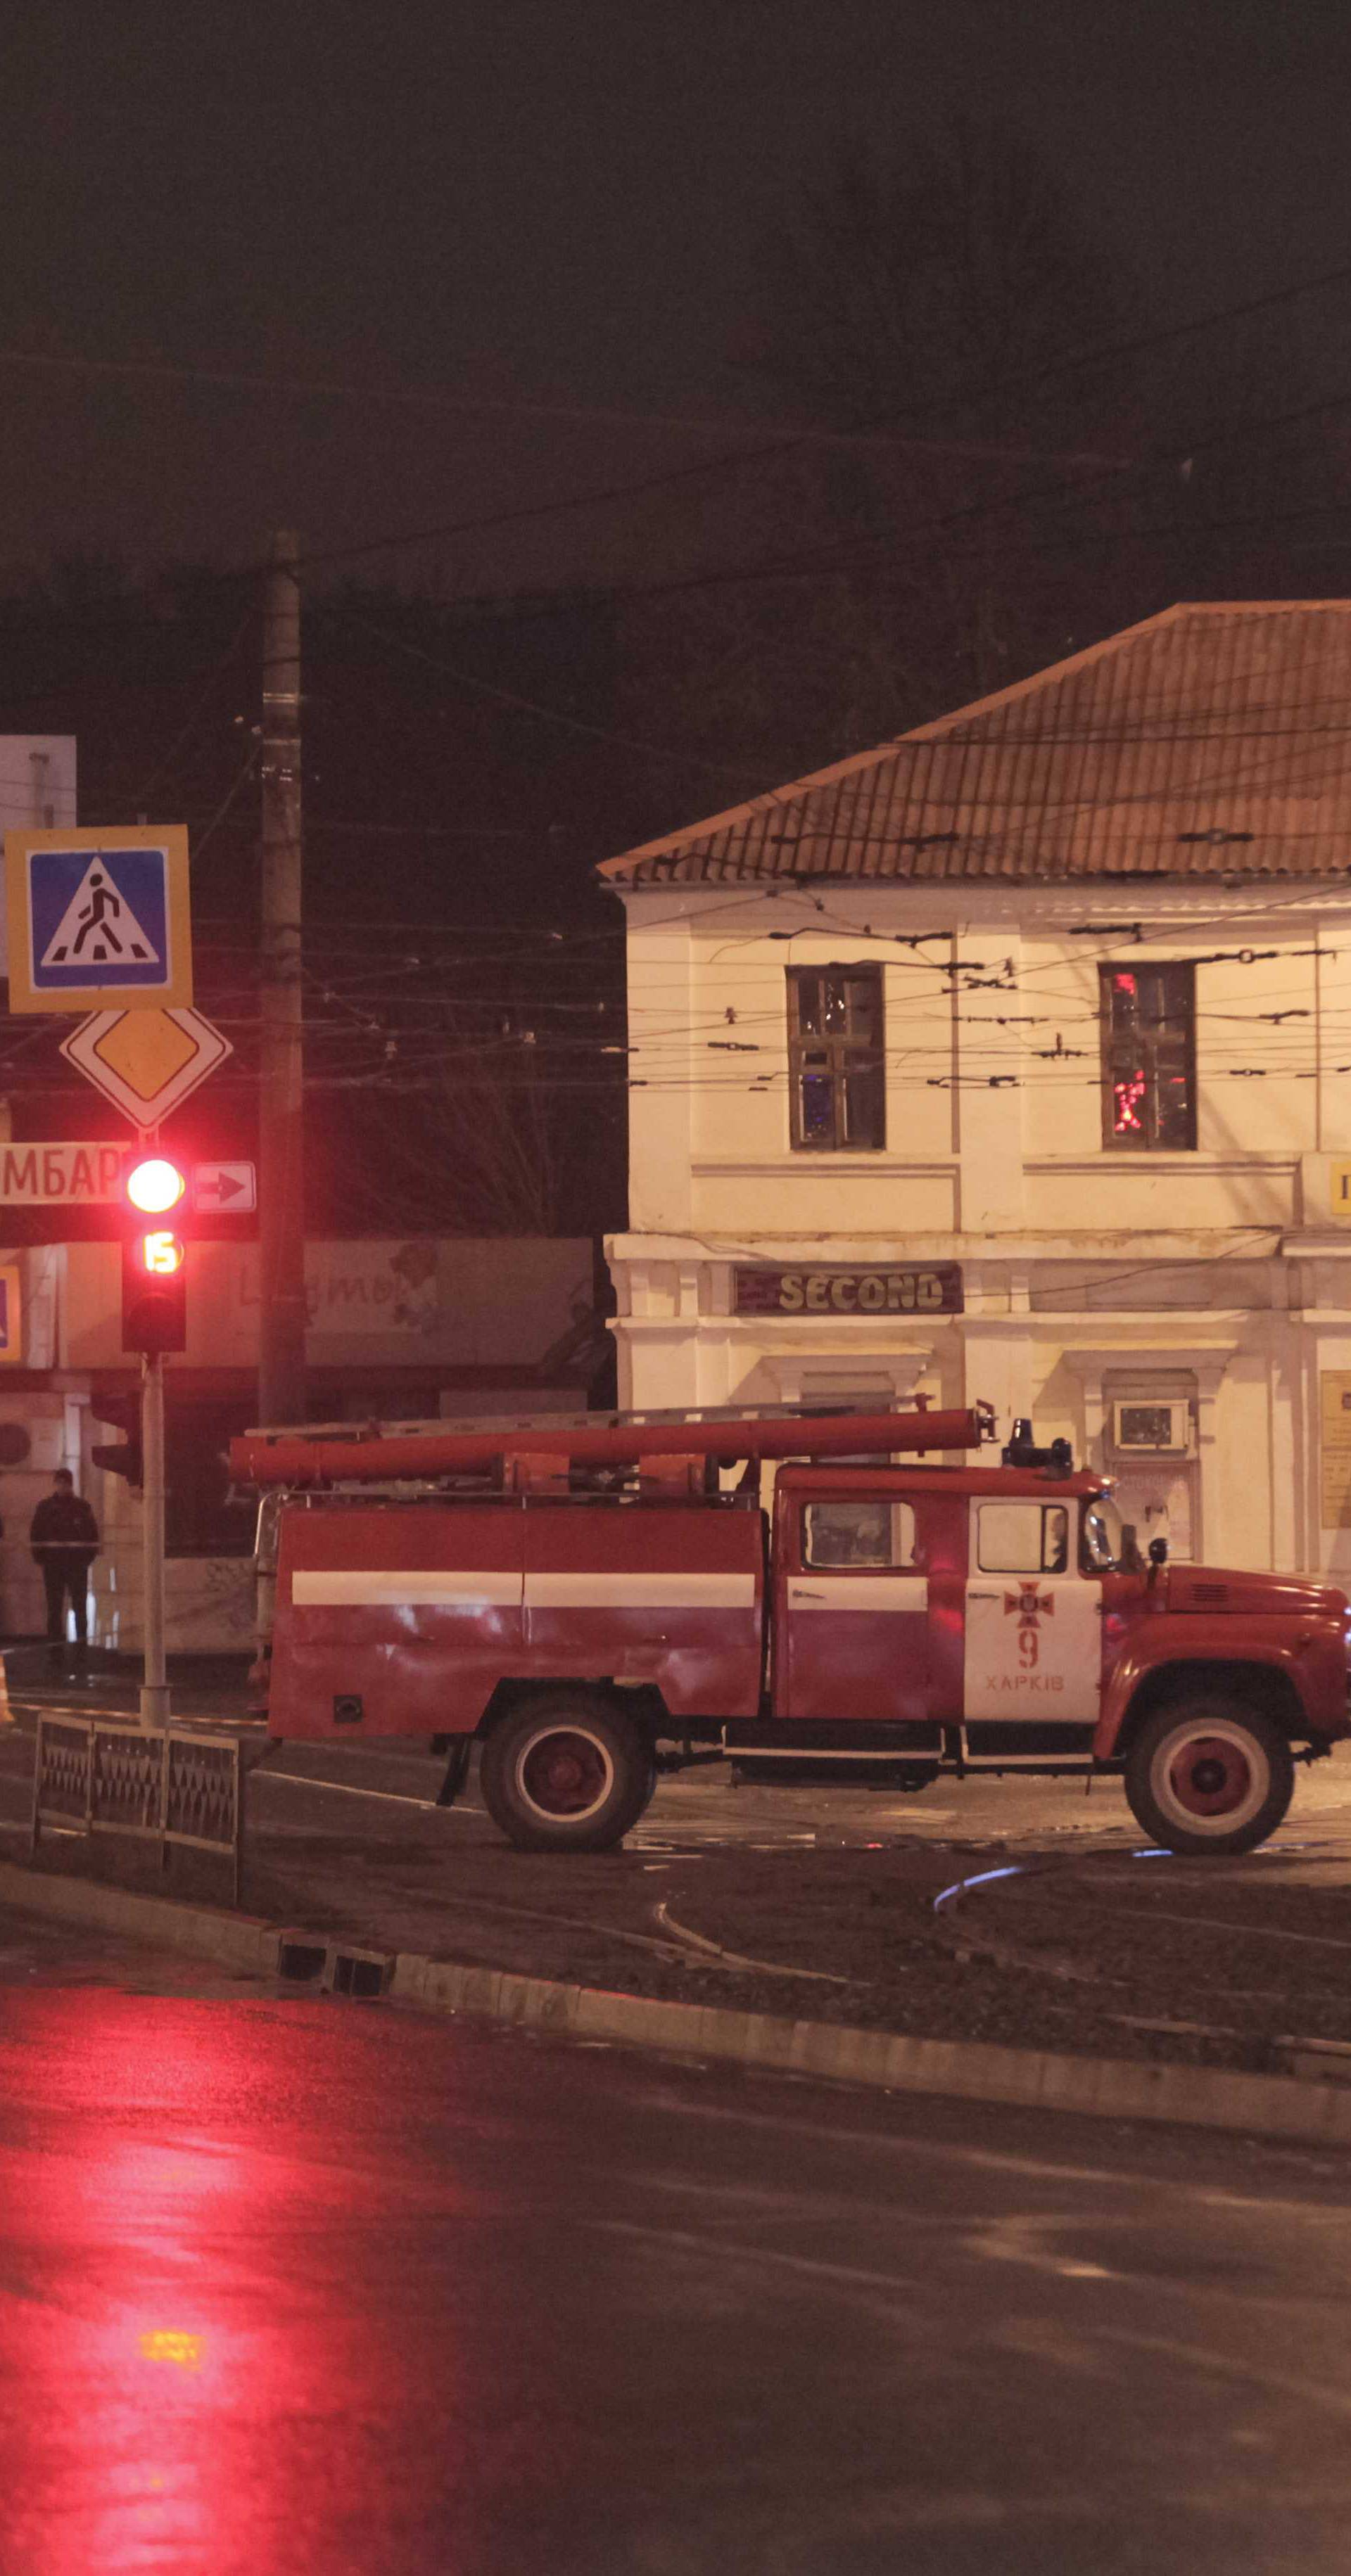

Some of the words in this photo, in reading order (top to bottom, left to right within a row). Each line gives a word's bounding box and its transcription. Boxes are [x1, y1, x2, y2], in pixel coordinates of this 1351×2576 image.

[779, 1273, 944, 1310] SECOND
[1018, 1630, 1039, 1669] 9
[986, 1674, 1065, 1692] ХАРКІВ
